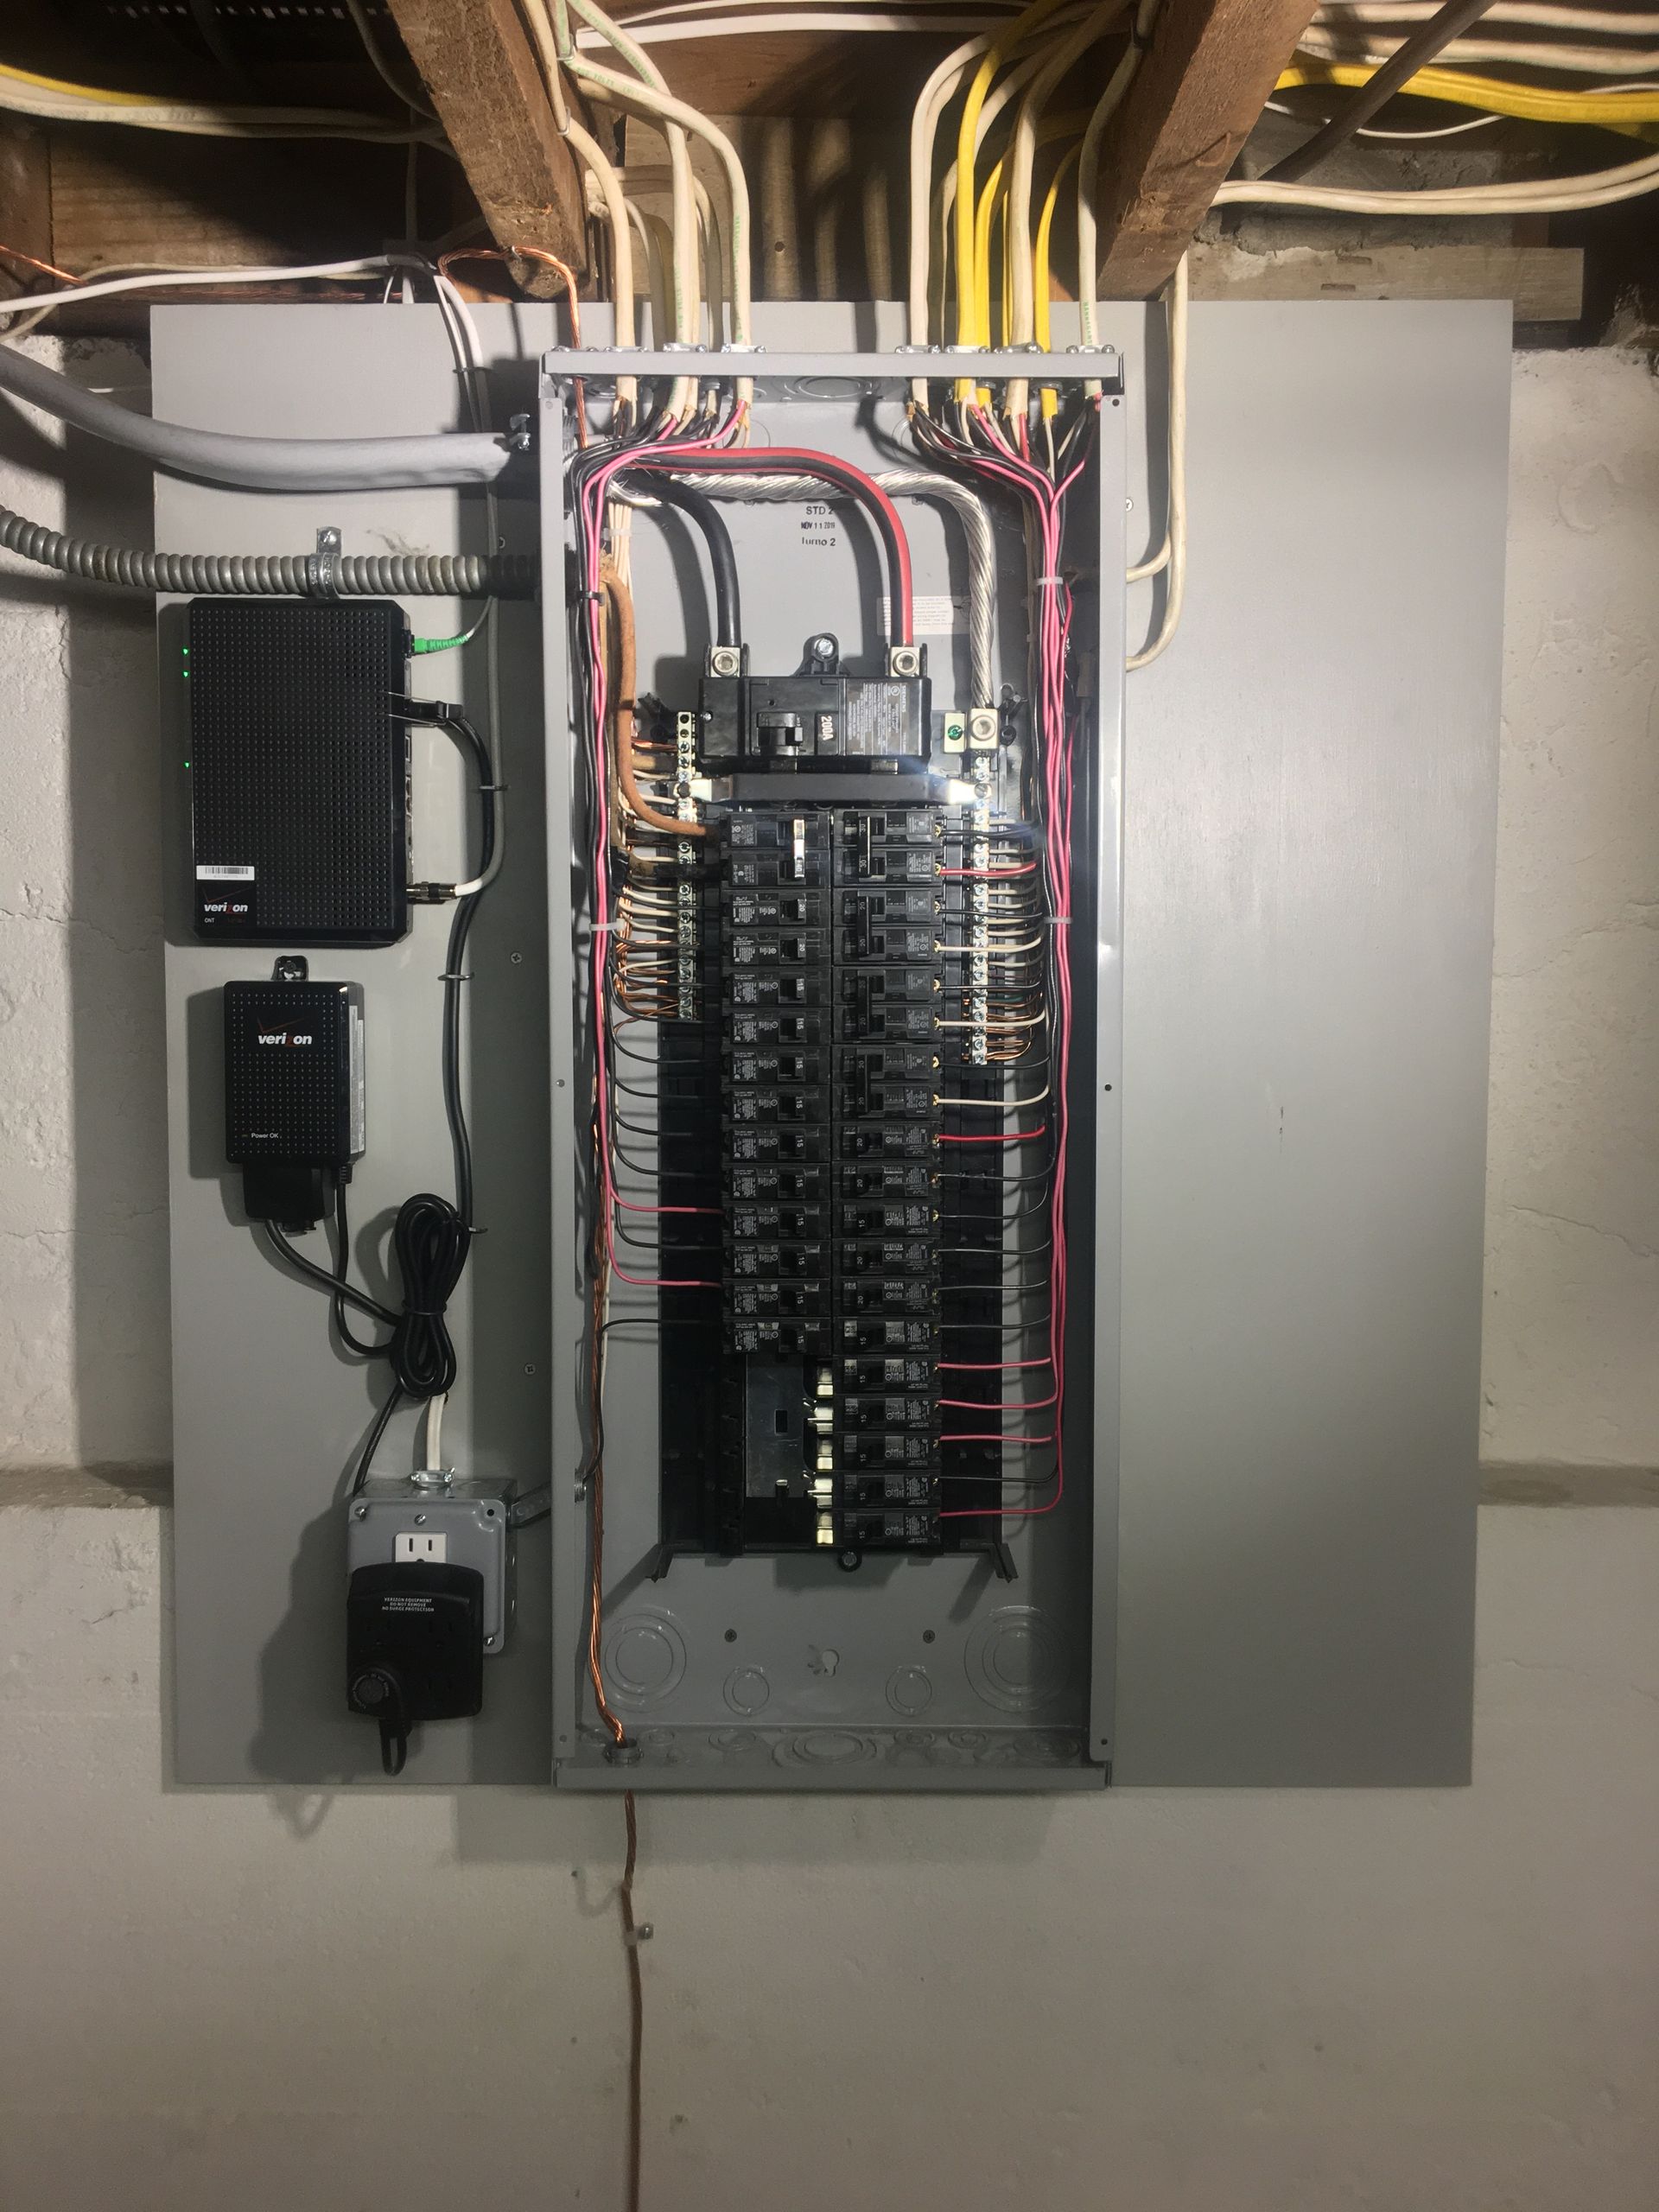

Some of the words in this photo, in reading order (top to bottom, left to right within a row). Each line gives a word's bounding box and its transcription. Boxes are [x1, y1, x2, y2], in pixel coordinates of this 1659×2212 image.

[805, 505, 826, 515] STD
[828, 506, 834, 515] 2
[800, 521, 812, 530] NOV
[830, 537, 836, 546] 2
[821, 715, 834, 741] 200A
[859, 823, 866, 833] 30
[859, 860, 867, 868] 30
[204, 902, 249, 914] verizon
[798, 904, 805, 912] 20
[859, 901, 865, 910] 20
[799, 944, 805, 952] 20
[258, 1032, 312, 1046] verizon
[858, 1060, 864, 1069] 20
[857, 1137, 863, 1147] 20
[857, 1179, 863, 1188] 20
[859, 1219, 866, 1228] 15
[857, 1256, 863, 1265] 20
[797, 1295, 804, 1304] 15
[858, 1295, 864, 1305] 20
[798, 1335, 804, 1344] 15
[860, 1337, 867, 1345] 15
[860, 1375, 866, 1383] 15
[861, 1414, 868, 1423] 15
[860, 1453, 867, 1462] 15
[860, 1491, 866, 1501] 15
[859, 1530, 866, 1539] 15
